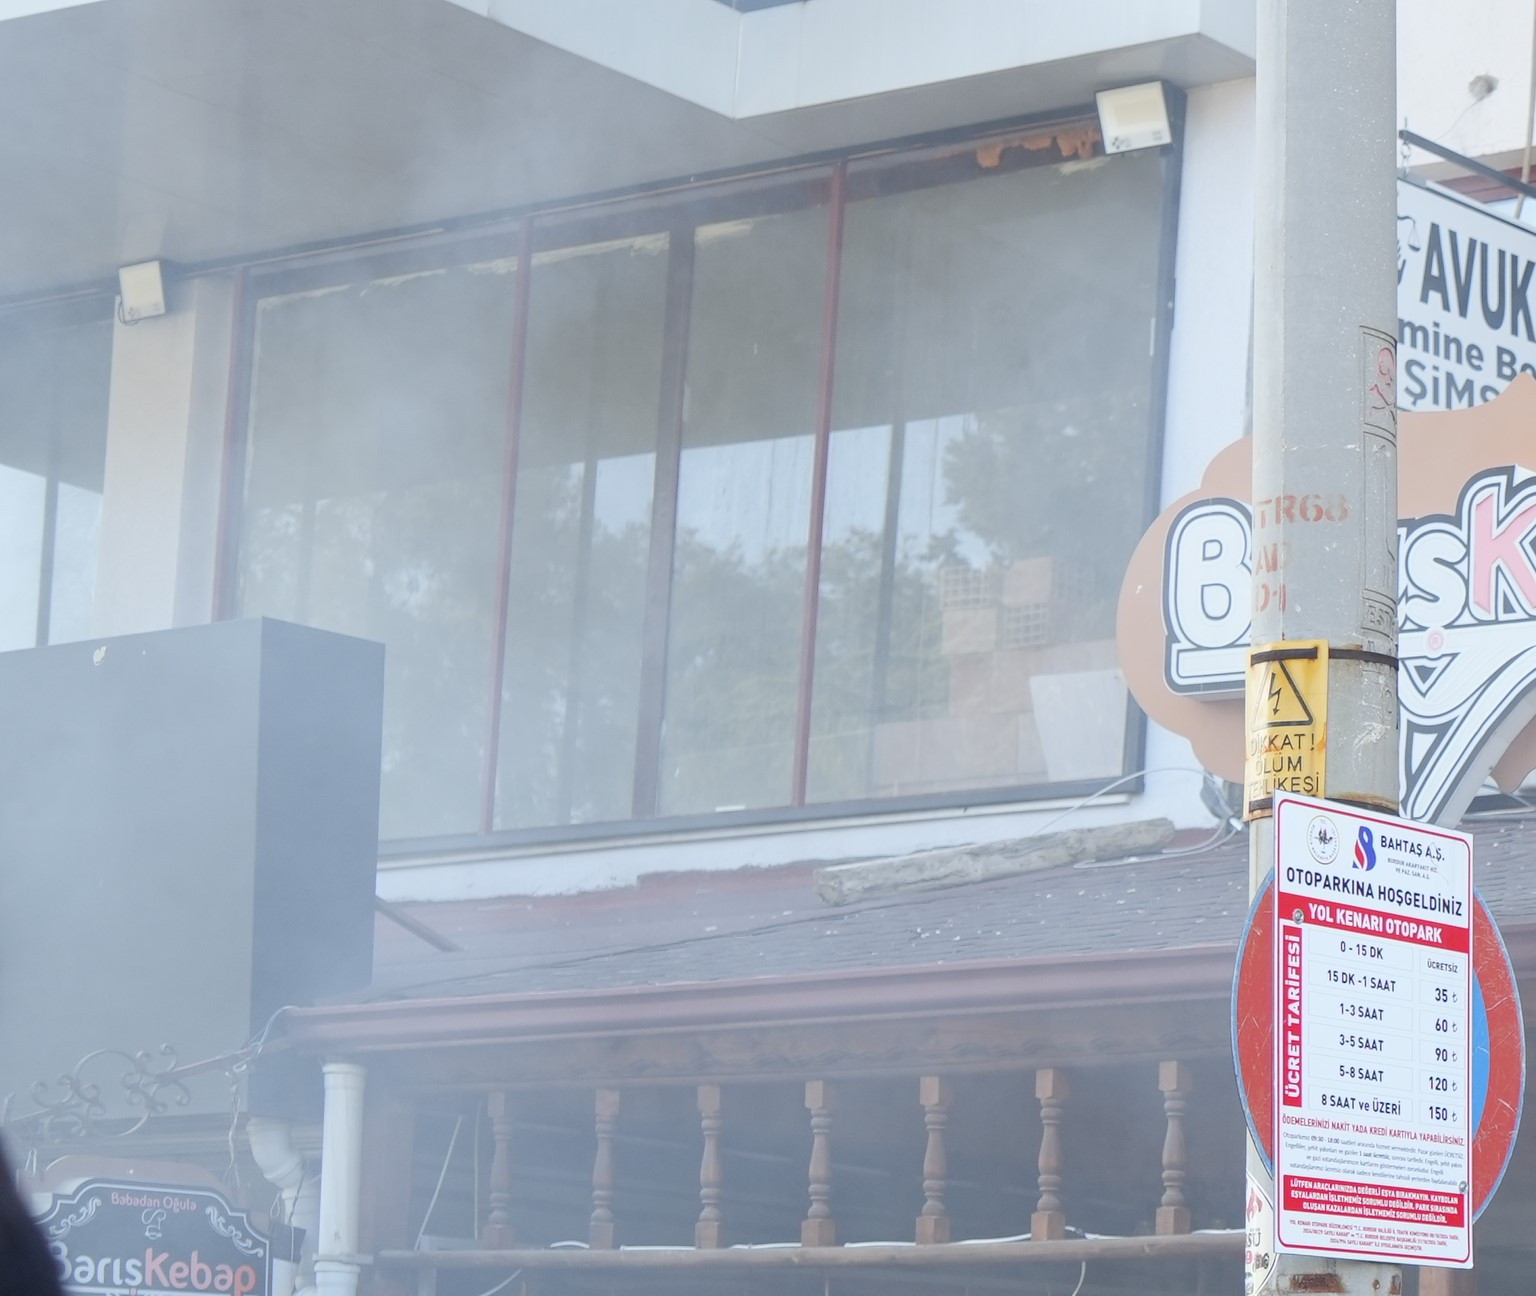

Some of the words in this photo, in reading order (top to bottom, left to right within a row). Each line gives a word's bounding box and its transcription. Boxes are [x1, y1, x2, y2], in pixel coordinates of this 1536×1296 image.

[1397, 318, 1483, 371] mine
[1255, 754, 1302, 775] ÖLÜM
[1381, 835, 1422, 858] BAHTAŞ
[1287, 867, 1374, 899] OTOPARKINA
[1378, 885, 1462, 916] HOŞGELDİNİZ
[1308, 903, 1333, 923] YOL
[1336, 908, 1383, 932] KENARI
[1385, 918, 1443, 943] OTOPARK
[1340, 941, 1345, 952] 0
[1356, 944, 1367, 957] 15
[1370, 947, 1383, 960] DK
[1427, 958, 1458, 974] ÜCRETSİZ
[1285, 935, 1300, 1027] TARİFESİ
[1327, 969, 1338, 982] 15
[1342, 972, 1355, 986] DK
[1370, 978, 1396, 992] SAAT
[1435, 988, 1448, 1003] 35
[1340, 1003, 1356, 1017] 1-3
[1358, 1006, 1384, 1021] SAAT
[1435, 1018, 1448, 1033] 60
[1339, 1034, 1355, 1047] 3-5
[1358, 1036, 1384, 1051] SAAT
[1285, 1032, 1300, 1098] ÜCRET
[1435, 1048, 1448, 1062] 90
[1339, 1065, 1355, 1078] 5-8
[1358, 1067, 1384, 1082] SAAT
[1429, 1076, 1448, 1092] 120
[1321, 1094, 1327, 1106] 8
[1330, 1094, 1356, 1110] SAAT
[1359, 1101, 1370, 1111] ve
[1372, 1098, 1401, 1116] ÜZERİ
[1429, 1106, 1448, 1121] 150
[1282, 1114, 1330, 1130] ÖDEMELERİNİZİ
[1332, 1120, 1350, 1132] NAKİT
[1352, 1124, 1367, 1134] YADA
[1370, 1127, 1387, 1137] KREDİ
[1389, 1128, 1417, 1140] KARTIYLA
[1290, 1178, 1312, 1188] LÜTFEN
[111, 1192, 160, 1208] Babadan
[163, 1196, 197, 1213] Oğula
